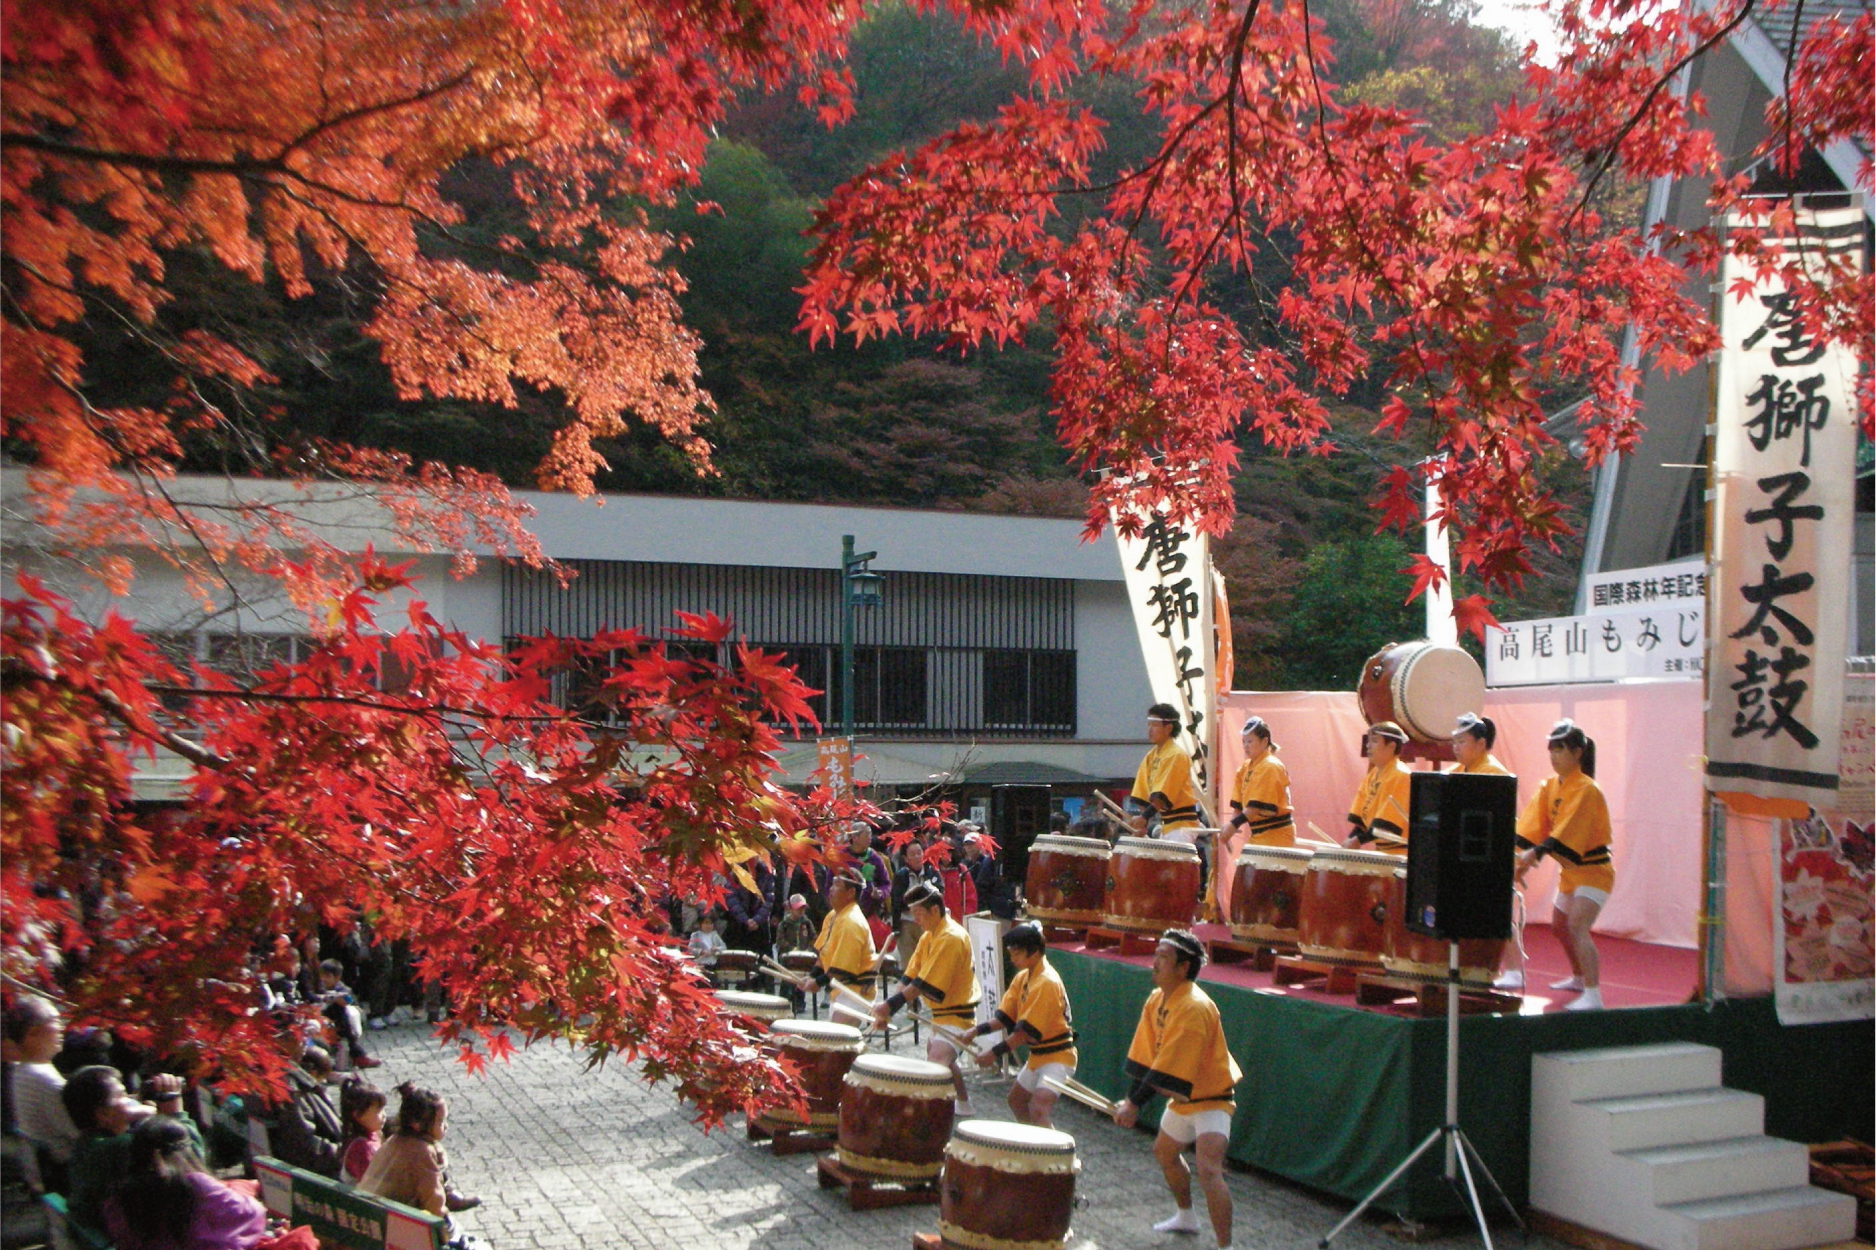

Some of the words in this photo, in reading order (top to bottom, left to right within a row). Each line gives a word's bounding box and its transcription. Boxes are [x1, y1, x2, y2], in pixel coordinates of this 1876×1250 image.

[1500, 611, 1699, 662] 高尾山もみじ
[1728, 293, 1830, 750] 唐獅子太鼓
